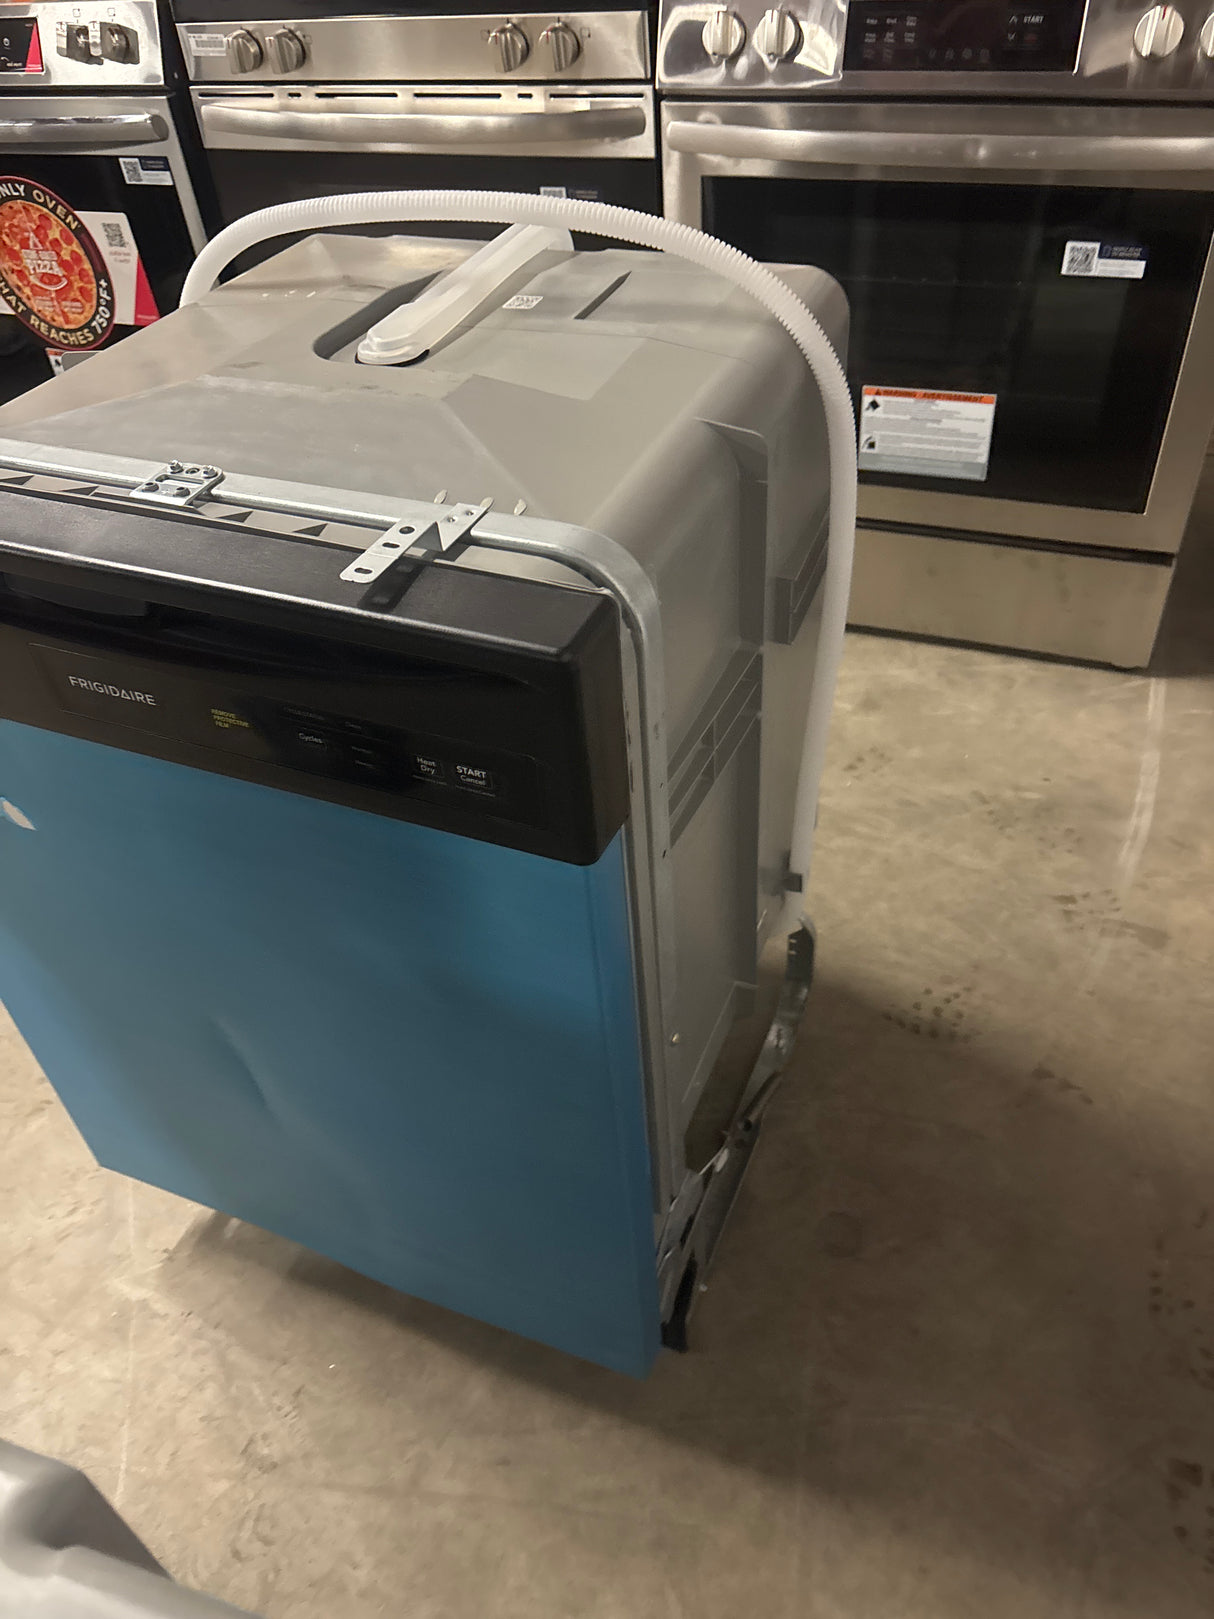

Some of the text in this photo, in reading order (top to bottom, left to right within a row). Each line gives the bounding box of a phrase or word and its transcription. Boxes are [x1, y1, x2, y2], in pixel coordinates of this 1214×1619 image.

[0, 182, 79, 230] NLY OVEN
[25, 260, 64, 277] PIZZA
[0, 278, 27, 313] HAT
[30, 314, 95, 346] REACHES
[68, 675, 157, 706] FRIGIDAIRE
[298, 732, 324, 744] Cycles
[416, 756, 437, 767] Heat
[420, 764, 436, 775] Dry
[456, 765, 487, 779] START
[460, 775, 487, 786] Cancel
